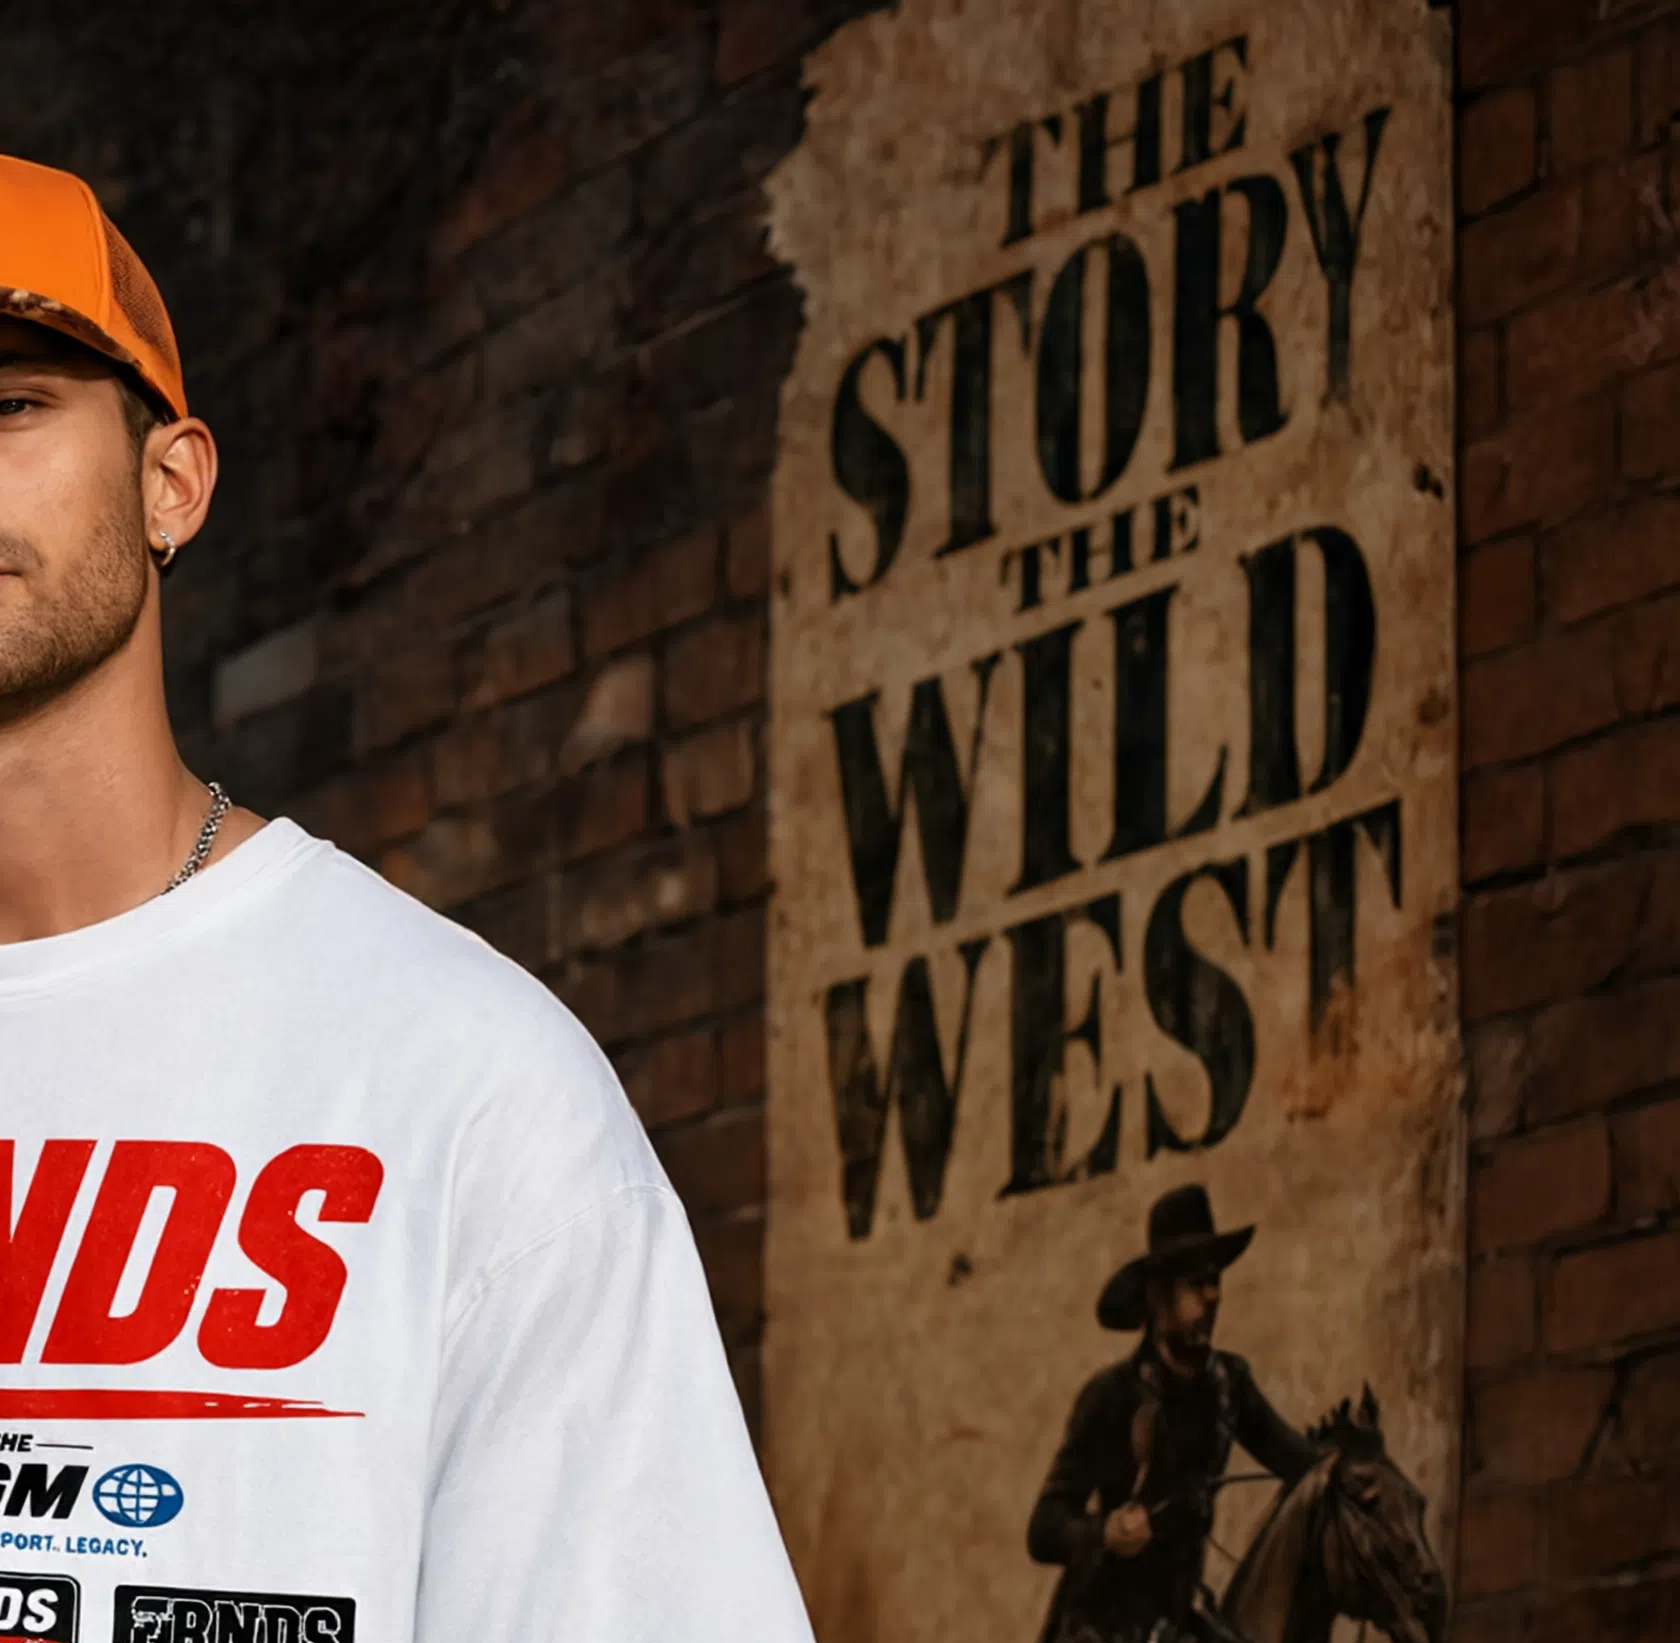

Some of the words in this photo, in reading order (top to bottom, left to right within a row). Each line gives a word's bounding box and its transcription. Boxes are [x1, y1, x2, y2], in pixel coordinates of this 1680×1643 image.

[982, 36, 1250, 248] THE
[828, 106, 1392, 600] STORY
[1000, 485, 1202, 614] THE
[825, 525, 1376, 951] WILD
[813, 798, 1404, 1242] WEST
[65, 1536, 148, 1558] LEGACY.
